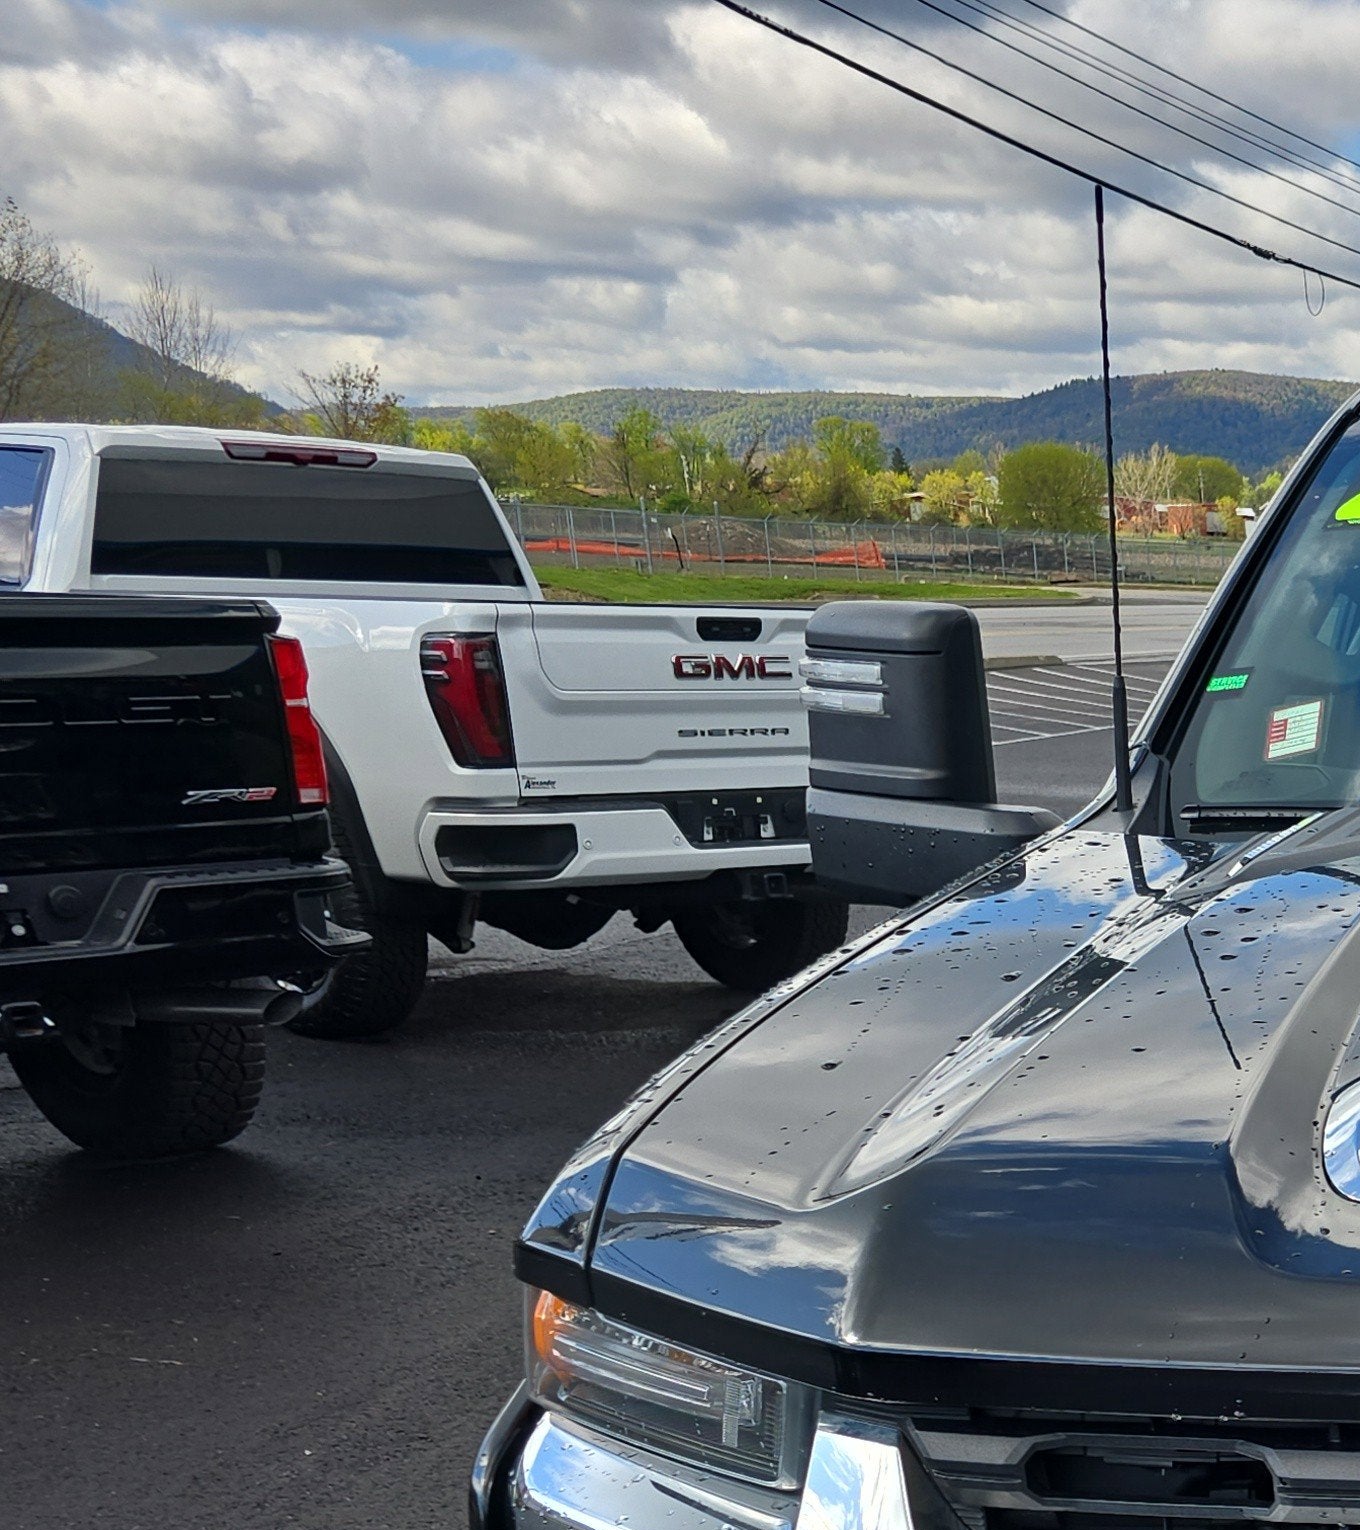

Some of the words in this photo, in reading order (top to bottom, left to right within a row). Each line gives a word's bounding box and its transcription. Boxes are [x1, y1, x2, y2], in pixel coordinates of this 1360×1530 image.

[671, 653, 793, 680] GMC
[678, 727, 790, 738] SIERRA
[181, 787, 277, 804] ZR2
